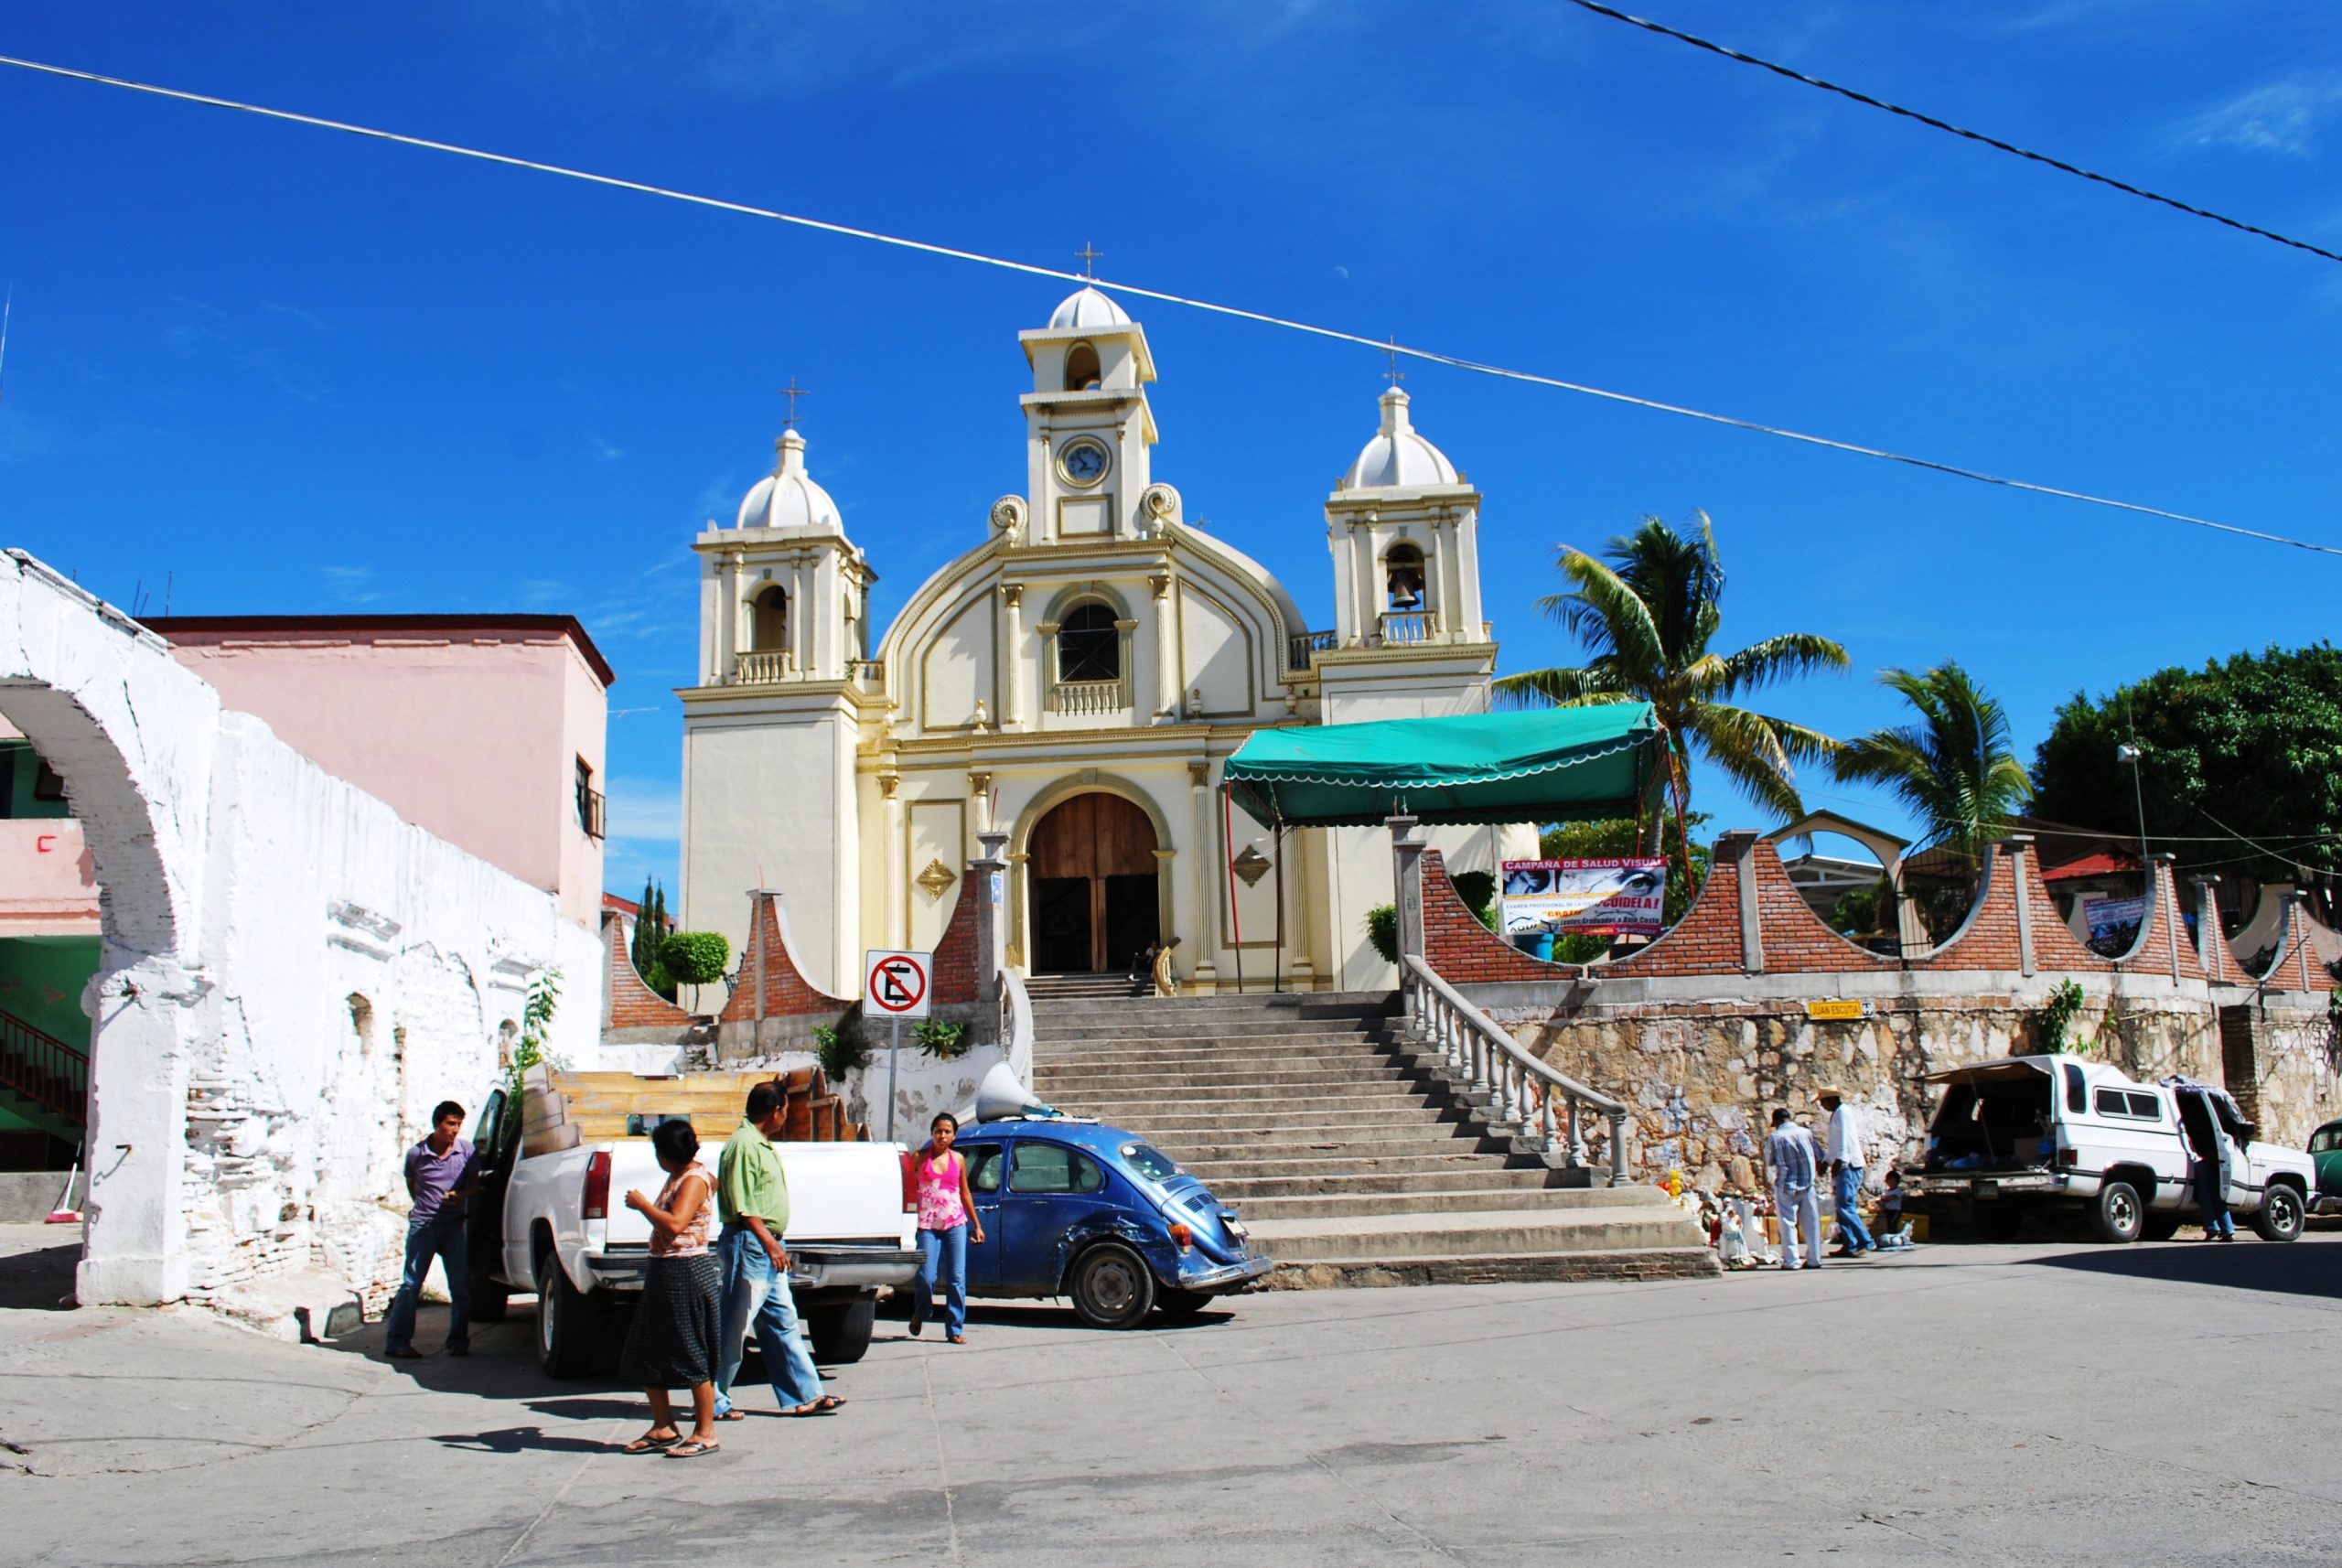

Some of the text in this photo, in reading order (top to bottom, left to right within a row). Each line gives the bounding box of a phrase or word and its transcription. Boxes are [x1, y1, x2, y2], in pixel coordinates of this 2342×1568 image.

[1506, 860, 1560, 870] CAMPAÑA
[1563, 860, 1578, 868] DE
[1581, 859, 1619, 868] SALUD
[1812, 1004, 1830, 1015] JUAN
